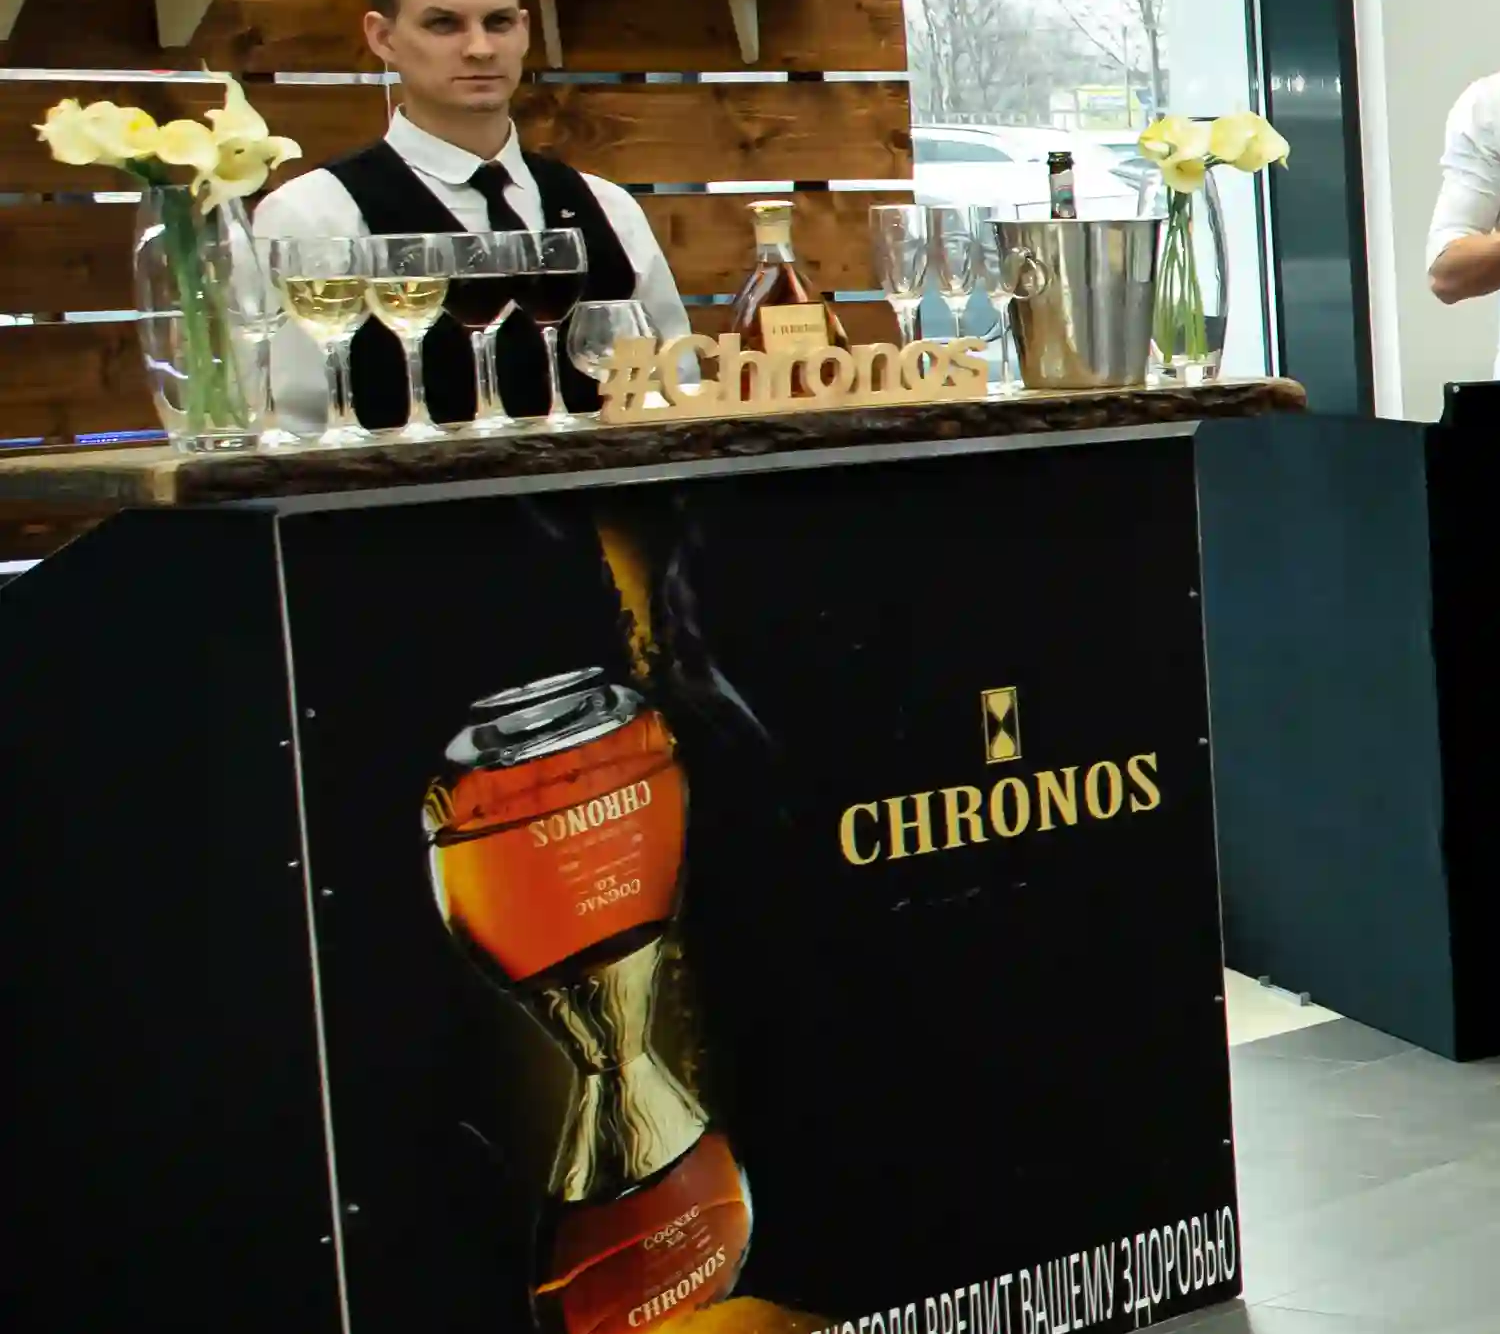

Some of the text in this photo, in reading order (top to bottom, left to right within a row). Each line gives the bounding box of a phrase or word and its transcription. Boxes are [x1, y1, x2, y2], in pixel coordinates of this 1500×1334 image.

[599, 331, 988, 423] #Chronos
[528, 780, 652, 848] CHRONOS
[839, 751, 1161, 866] CHRONOS
[628, 1244, 727, 1328] CHRONOS
[1120, 1204, 1237, 1329] ЗДОРОВЬЮ
